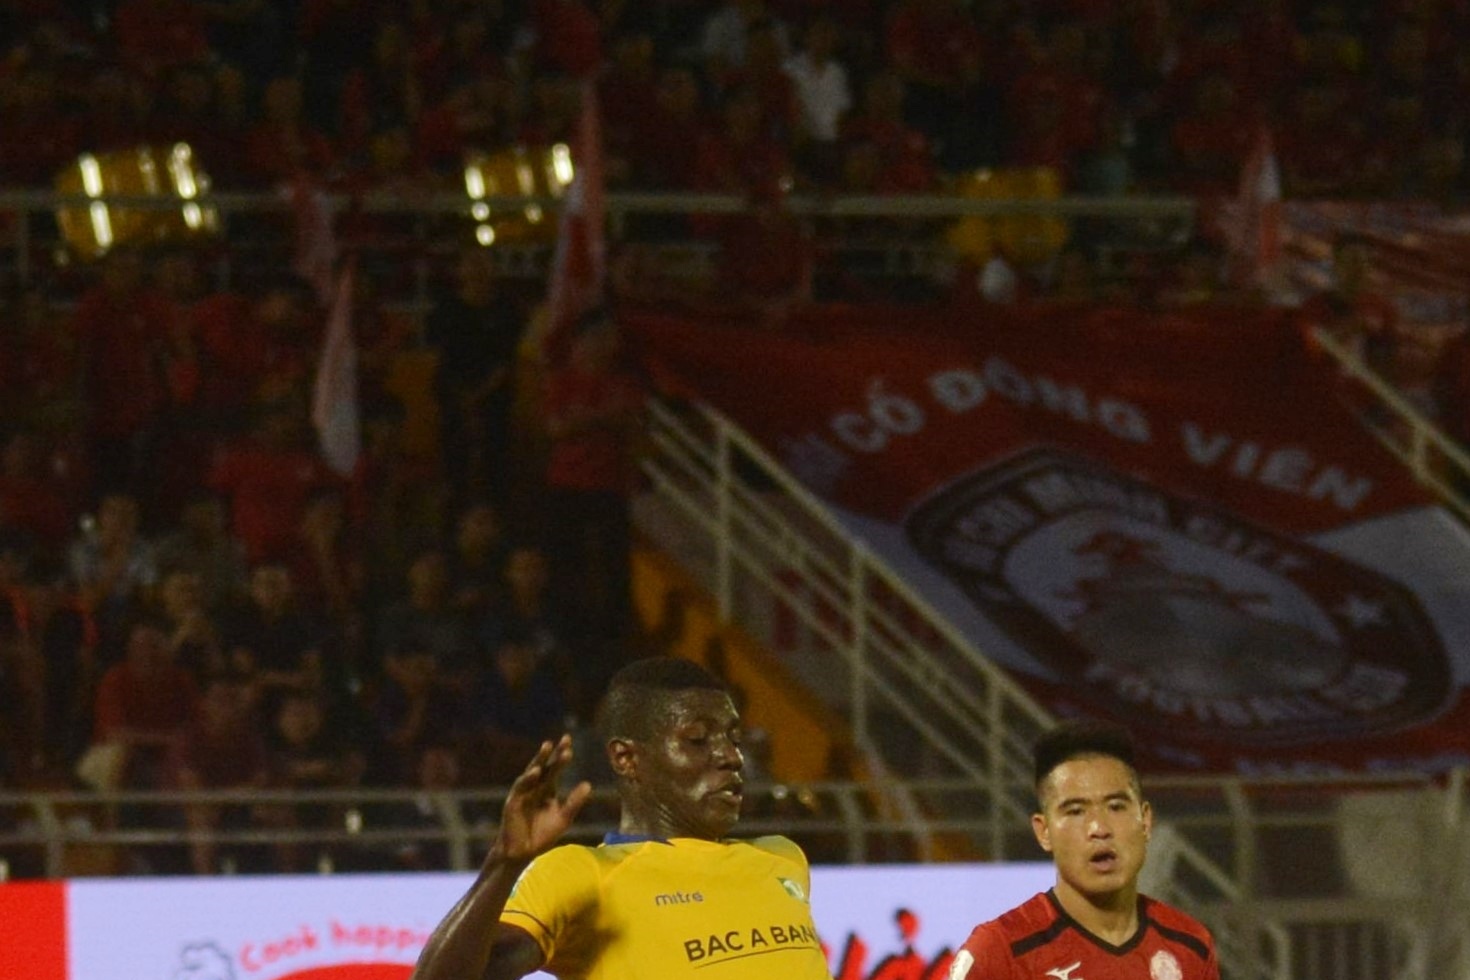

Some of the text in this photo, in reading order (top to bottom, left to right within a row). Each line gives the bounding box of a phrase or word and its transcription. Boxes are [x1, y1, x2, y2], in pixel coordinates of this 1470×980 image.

[655, 890, 704, 907] mitre
[240, 922, 318, 972] Cook
[684, 925, 820, 962] BAC A BAN
